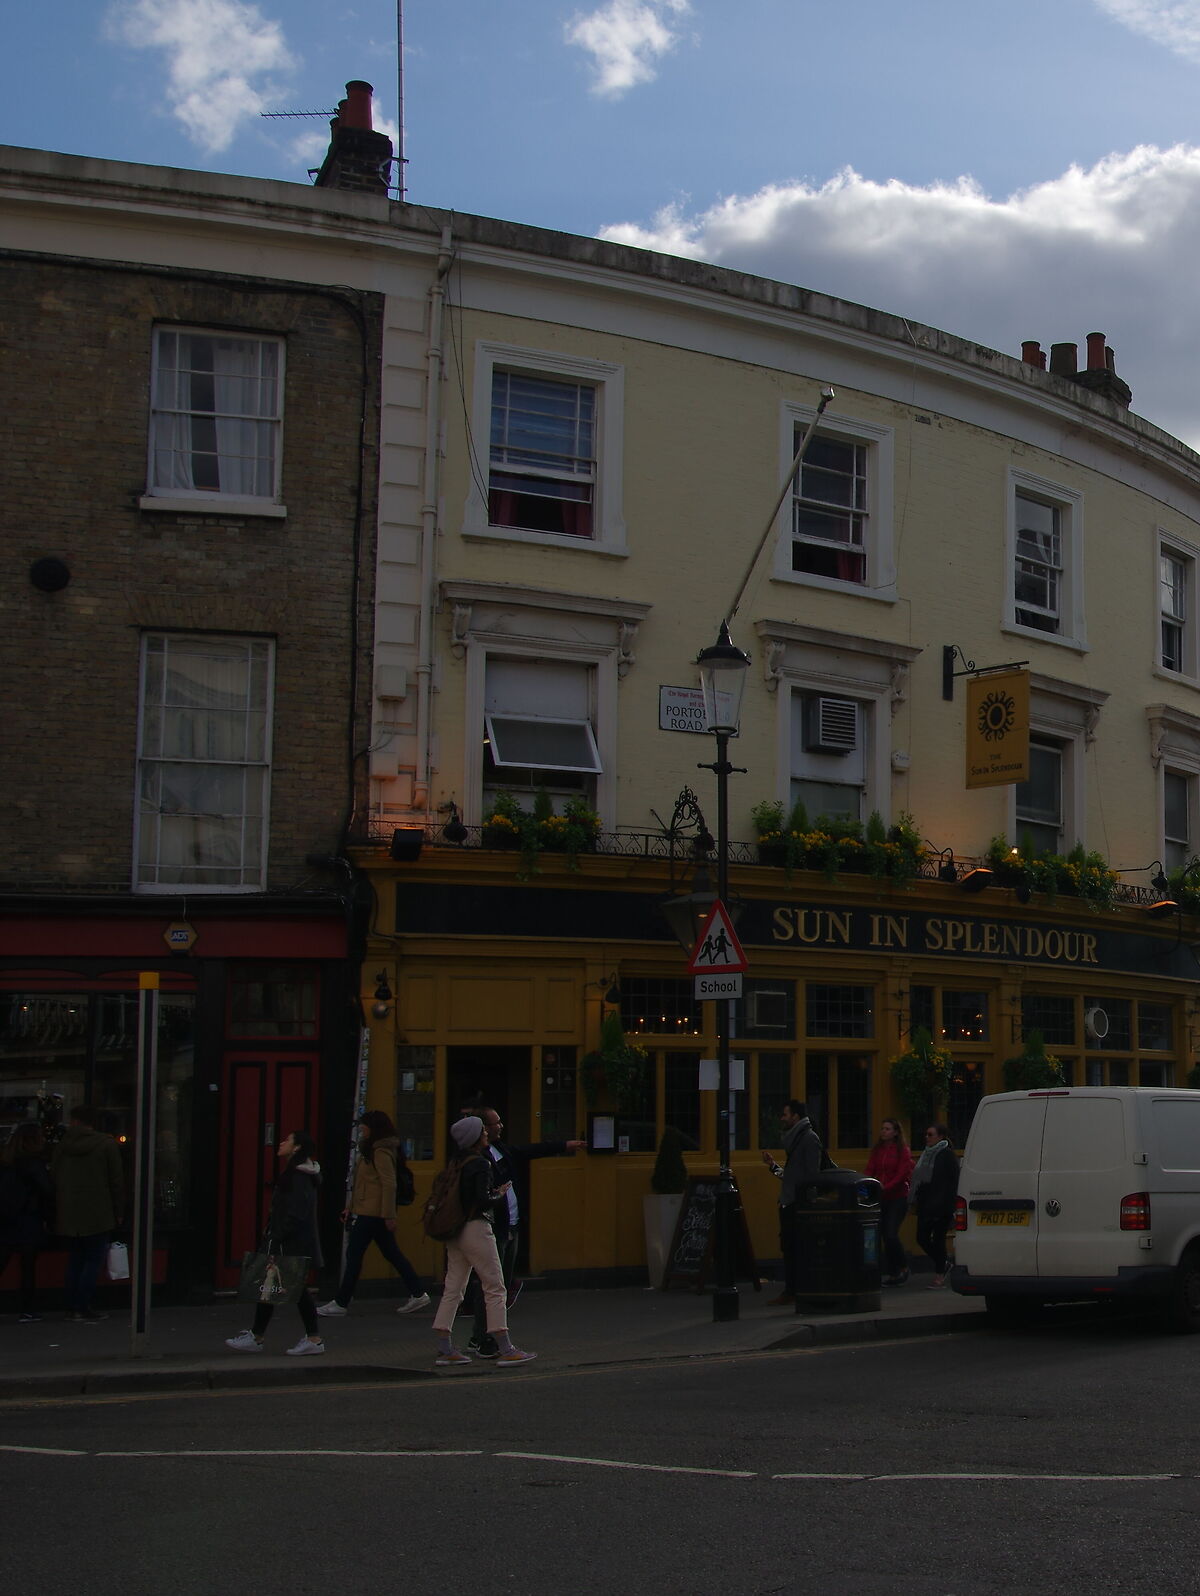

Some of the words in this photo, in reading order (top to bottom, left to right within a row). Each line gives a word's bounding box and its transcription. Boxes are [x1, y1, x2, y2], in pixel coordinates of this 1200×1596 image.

[772, 906, 853, 944] SUN
[869, 913, 910, 948] IN
[924, 917, 1099, 963] SPLENDOUR
[700, 980, 737, 993] School
